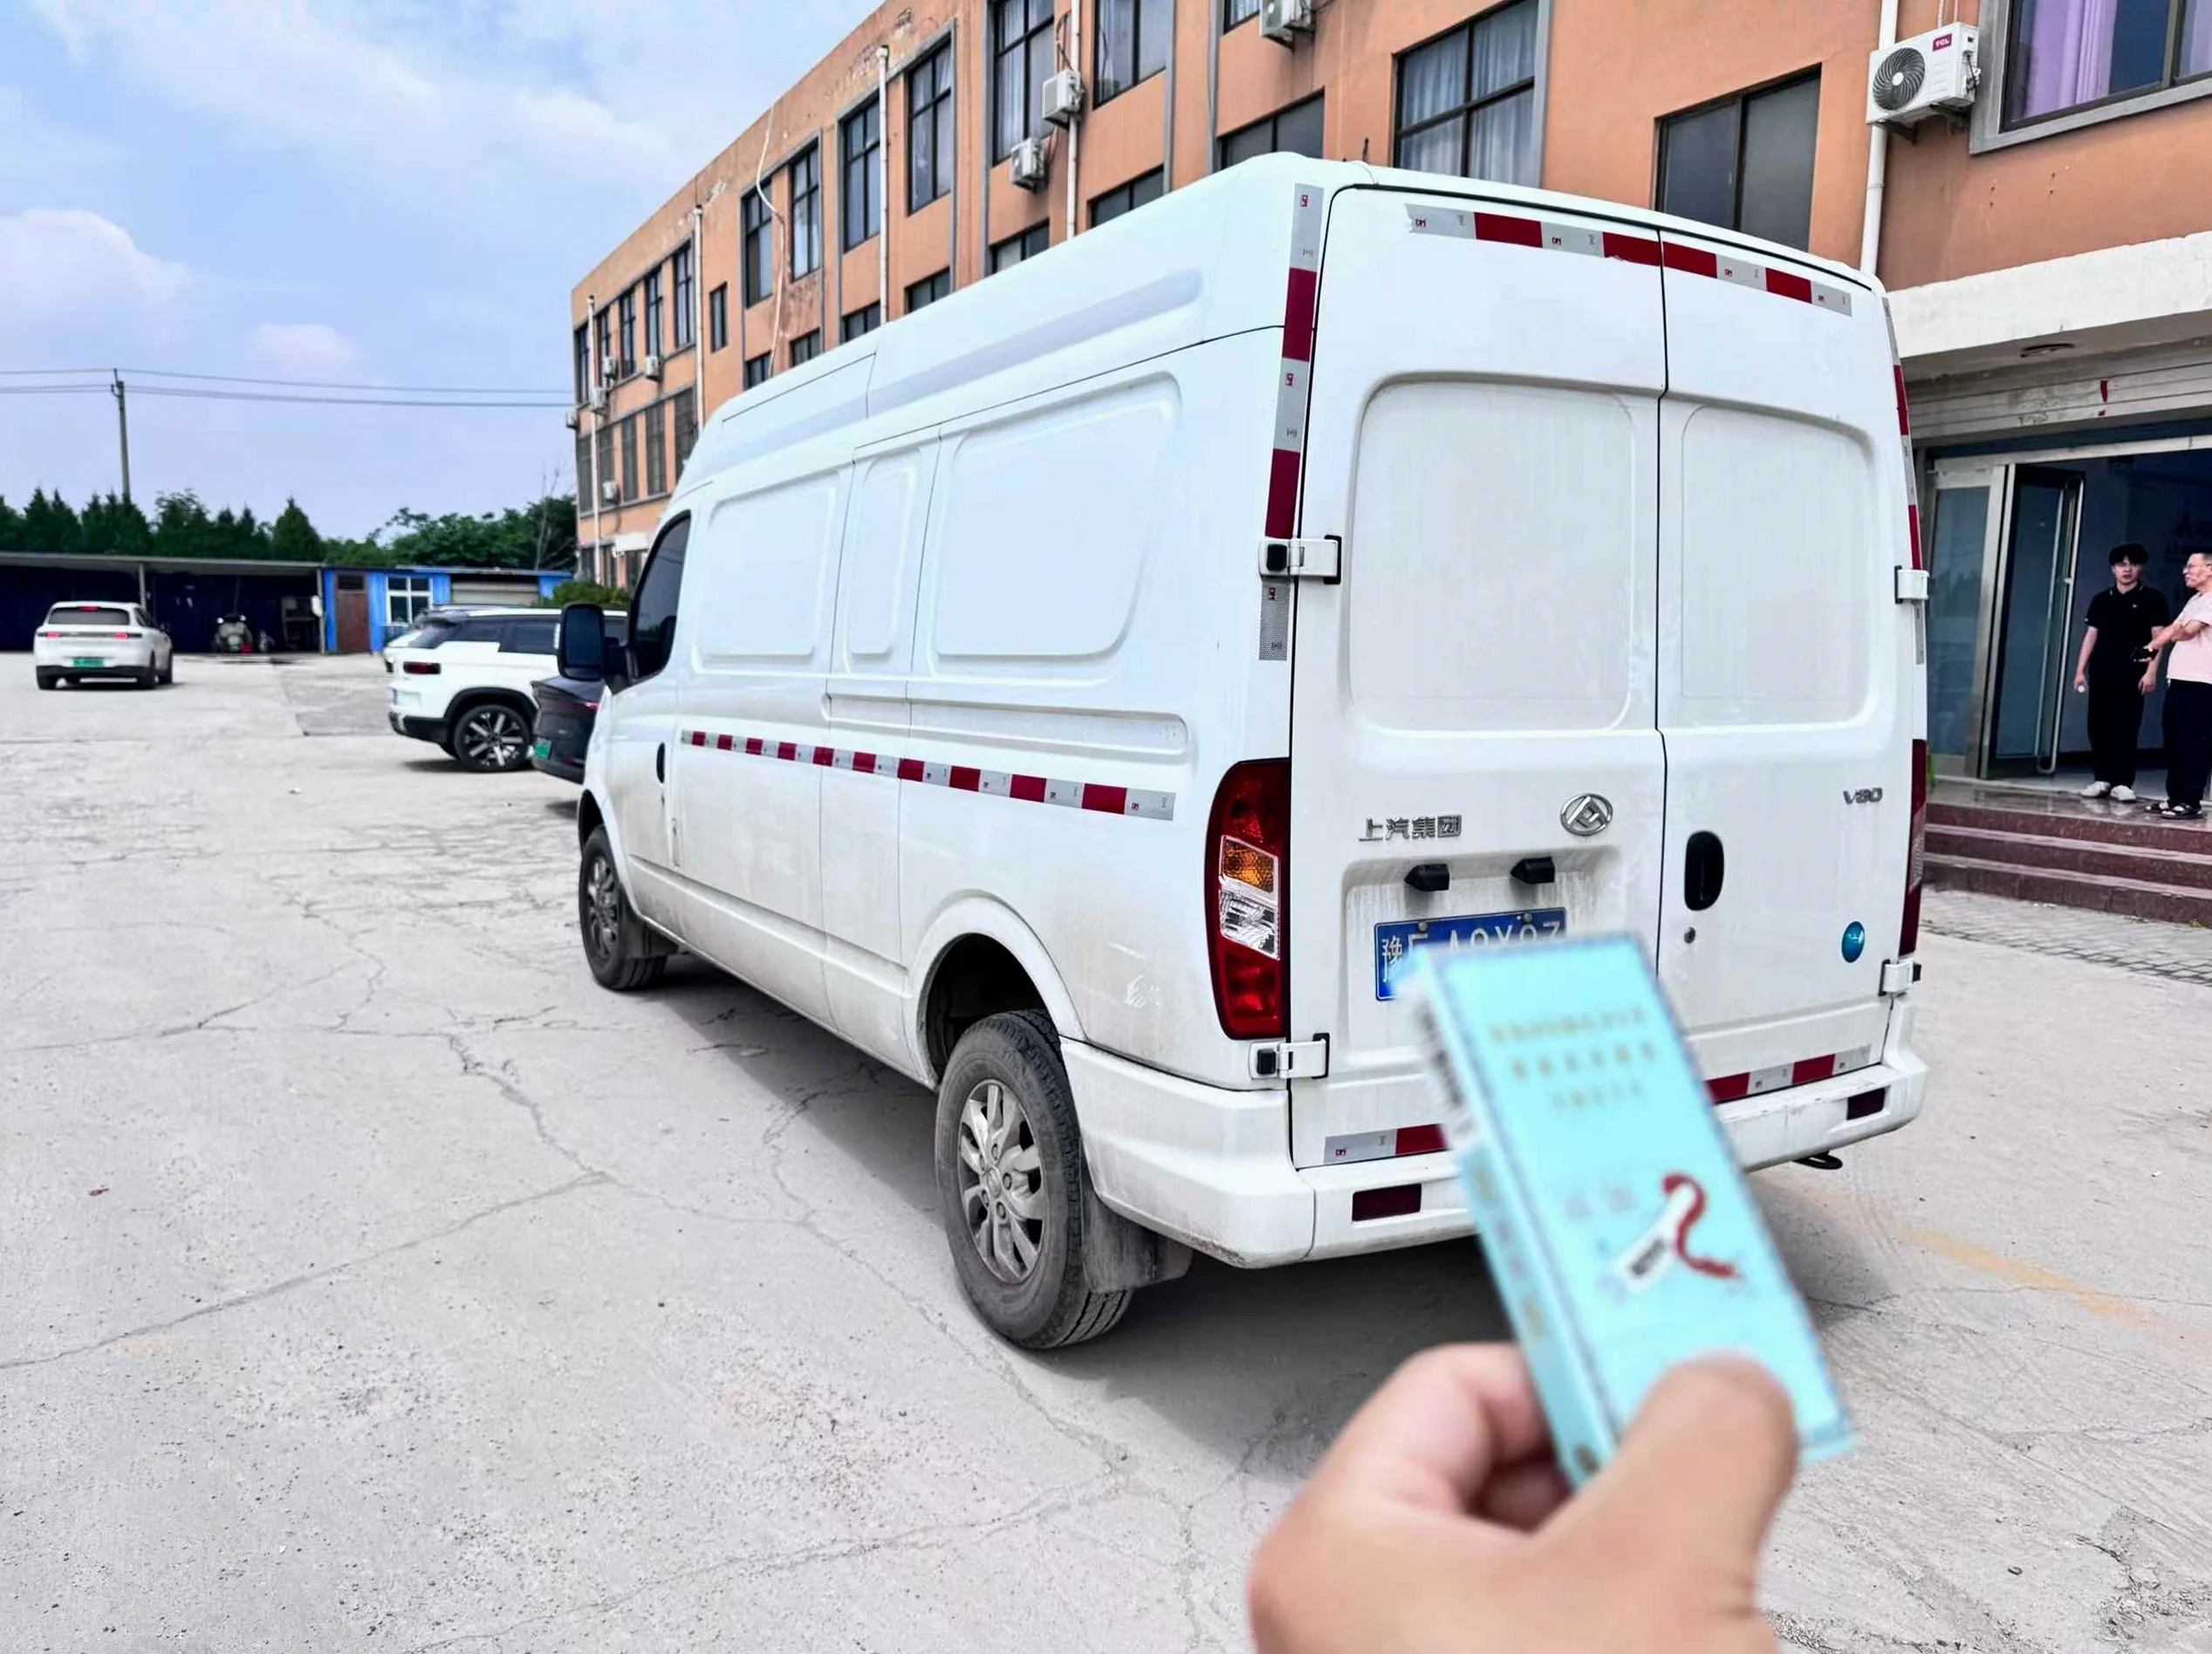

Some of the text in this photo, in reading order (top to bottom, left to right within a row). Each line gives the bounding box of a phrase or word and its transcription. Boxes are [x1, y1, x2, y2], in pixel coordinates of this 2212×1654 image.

[1935, 37, 1950, 48] TCL
[1842, 787, 1883, 804] V80
[1359, 815, 1461, 841] 上汽集团
